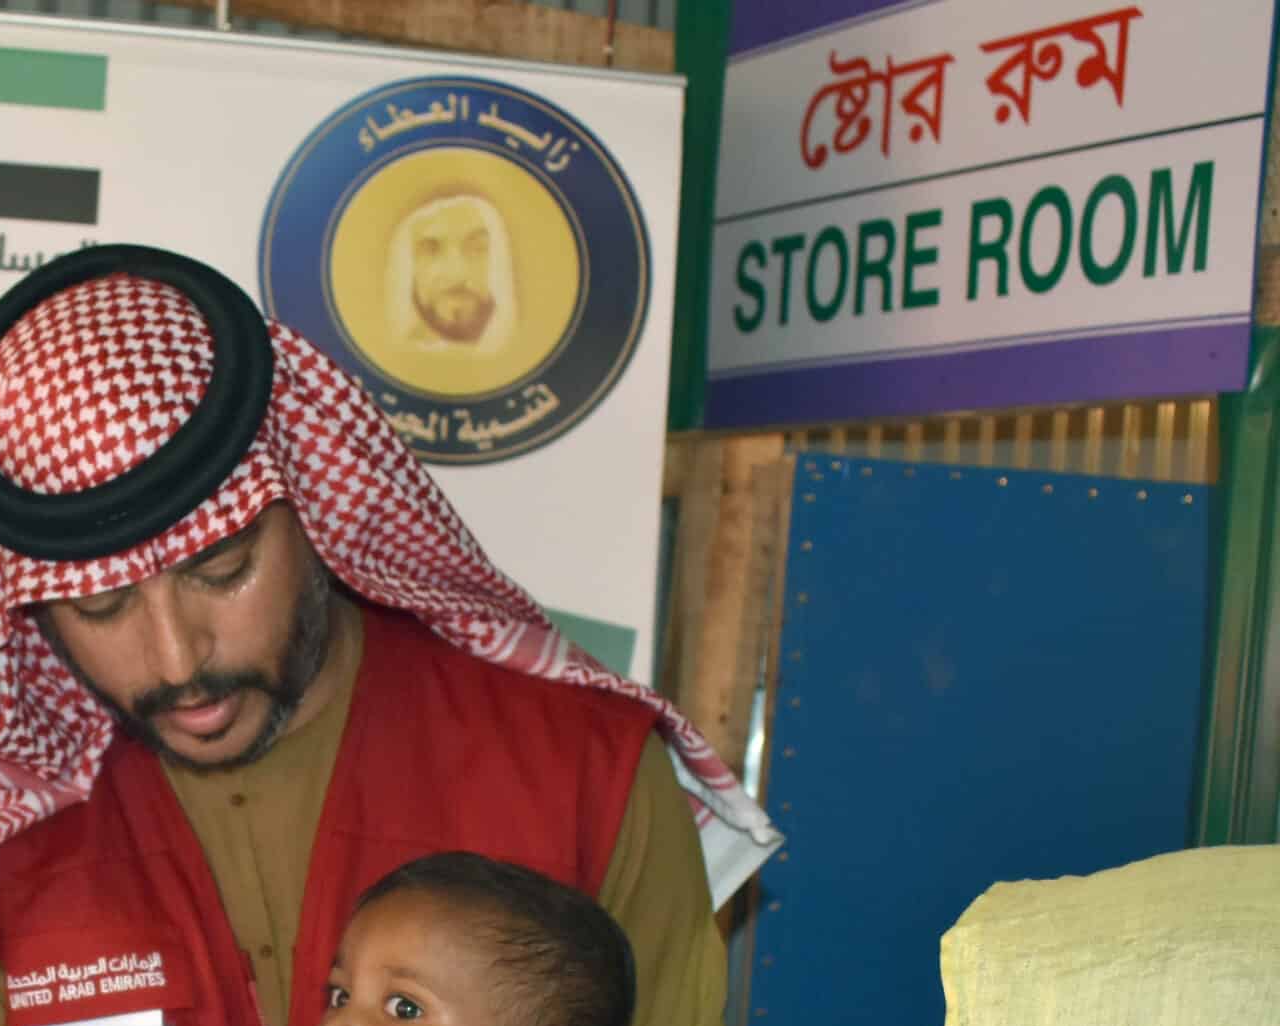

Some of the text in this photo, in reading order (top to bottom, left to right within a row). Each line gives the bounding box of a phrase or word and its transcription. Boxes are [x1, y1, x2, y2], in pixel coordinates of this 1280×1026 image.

[978, 5, 1144, 126] রুম
[358, 92, 470, 153] العطاء
[732, 160, 1216, 335] STORE ROOM
[6, 965, 56, 990] المتحد
[8, 970, 166, 1010] UNITED ARAB EMIRATES
[56, 956, 108, 982] العربية
